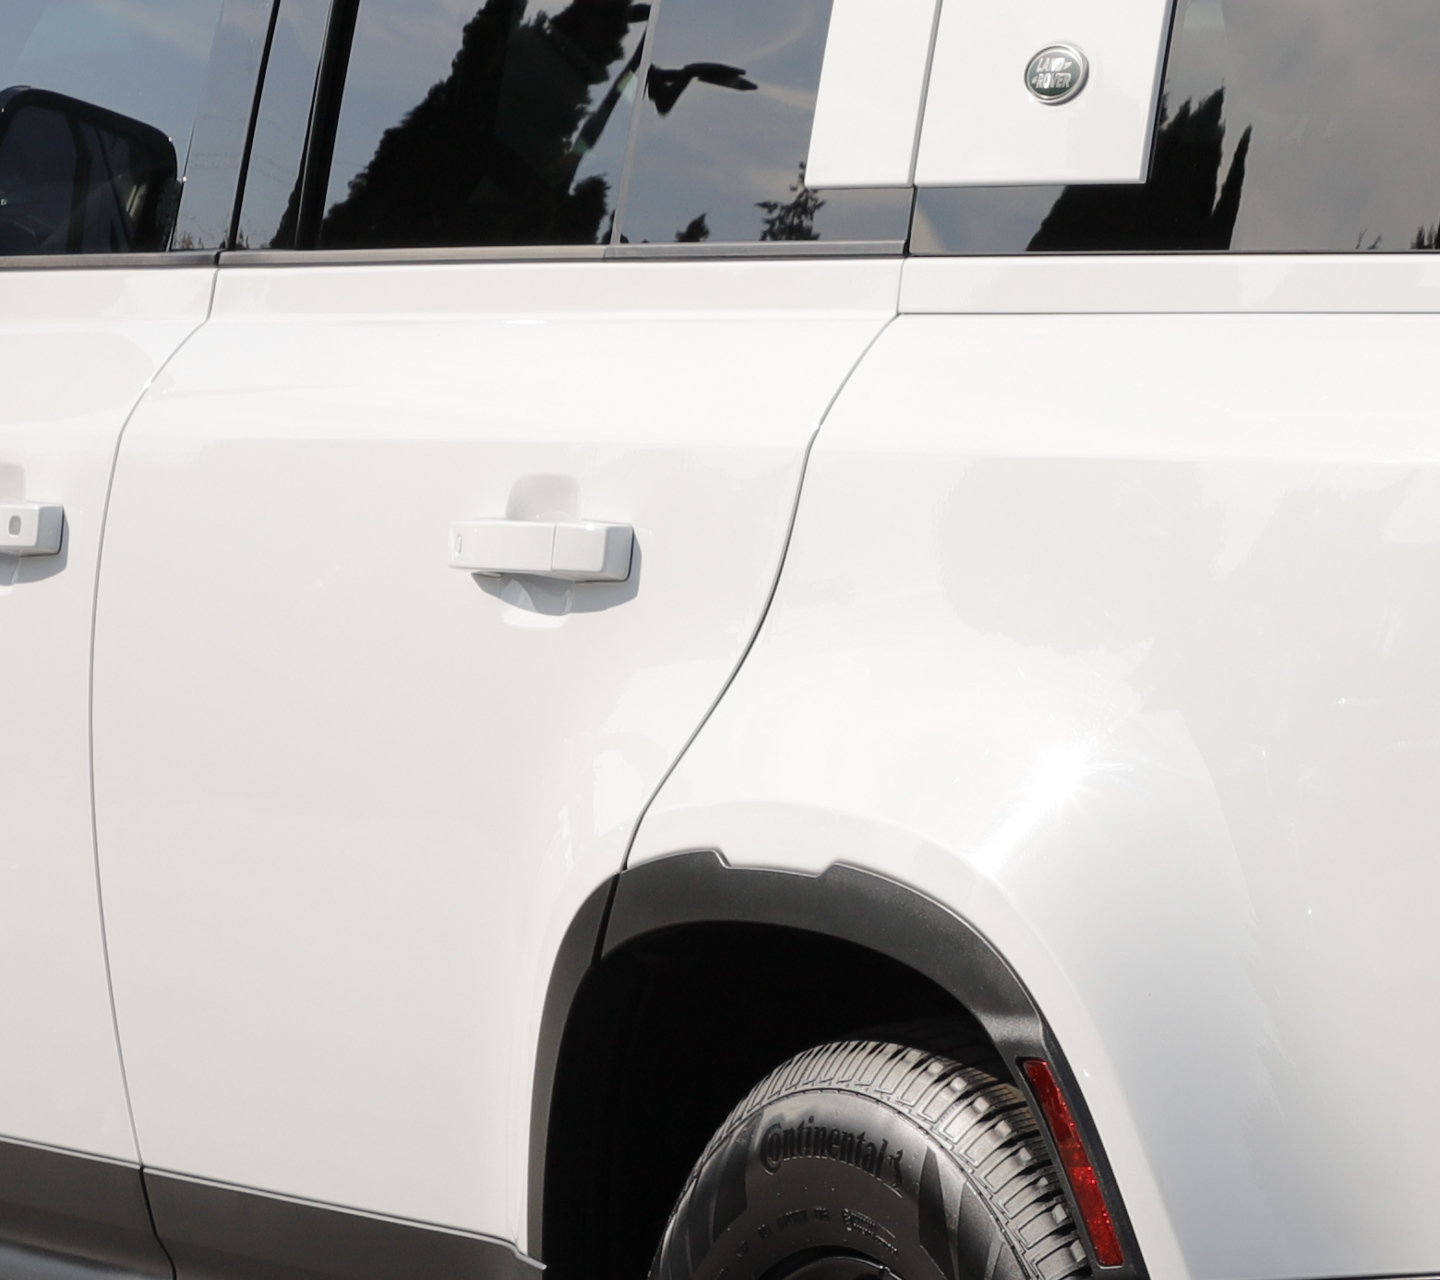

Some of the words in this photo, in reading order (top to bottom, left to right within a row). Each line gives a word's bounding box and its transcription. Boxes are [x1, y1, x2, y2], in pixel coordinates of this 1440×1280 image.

[1038, 58, 1063, 72] LAND
[1037, 73, 1071, 89] ROVER
[759, 1116, 888, 1181] Continental
